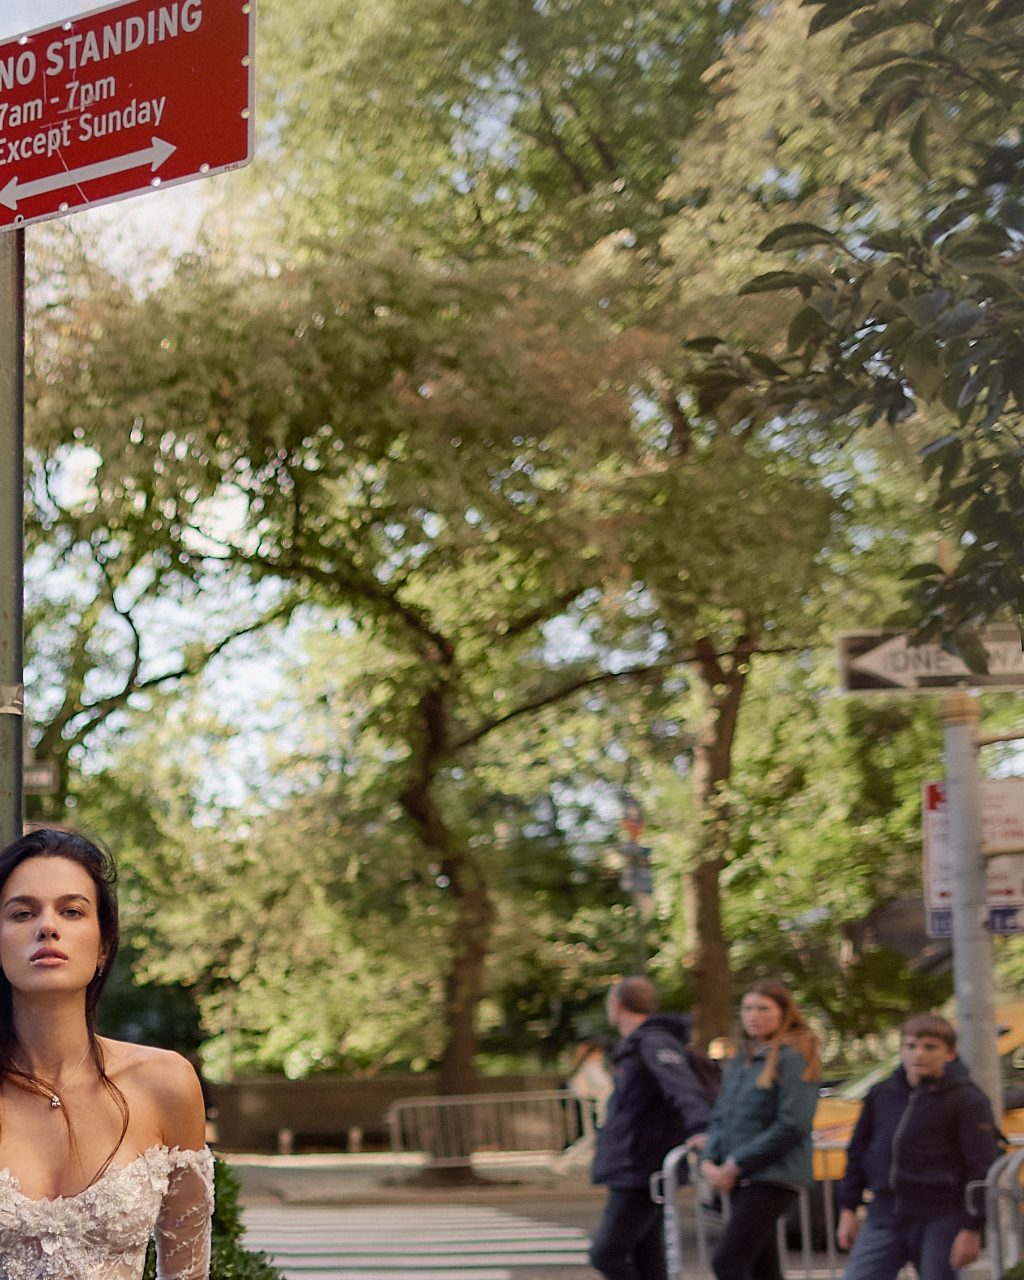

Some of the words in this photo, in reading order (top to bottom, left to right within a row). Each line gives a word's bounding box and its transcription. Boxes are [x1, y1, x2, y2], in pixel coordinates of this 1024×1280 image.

[45, 0, 202, 76] STANDING
[65, 75, 116, 112] 7pm
[78, 96, 166, 142] Sunday
